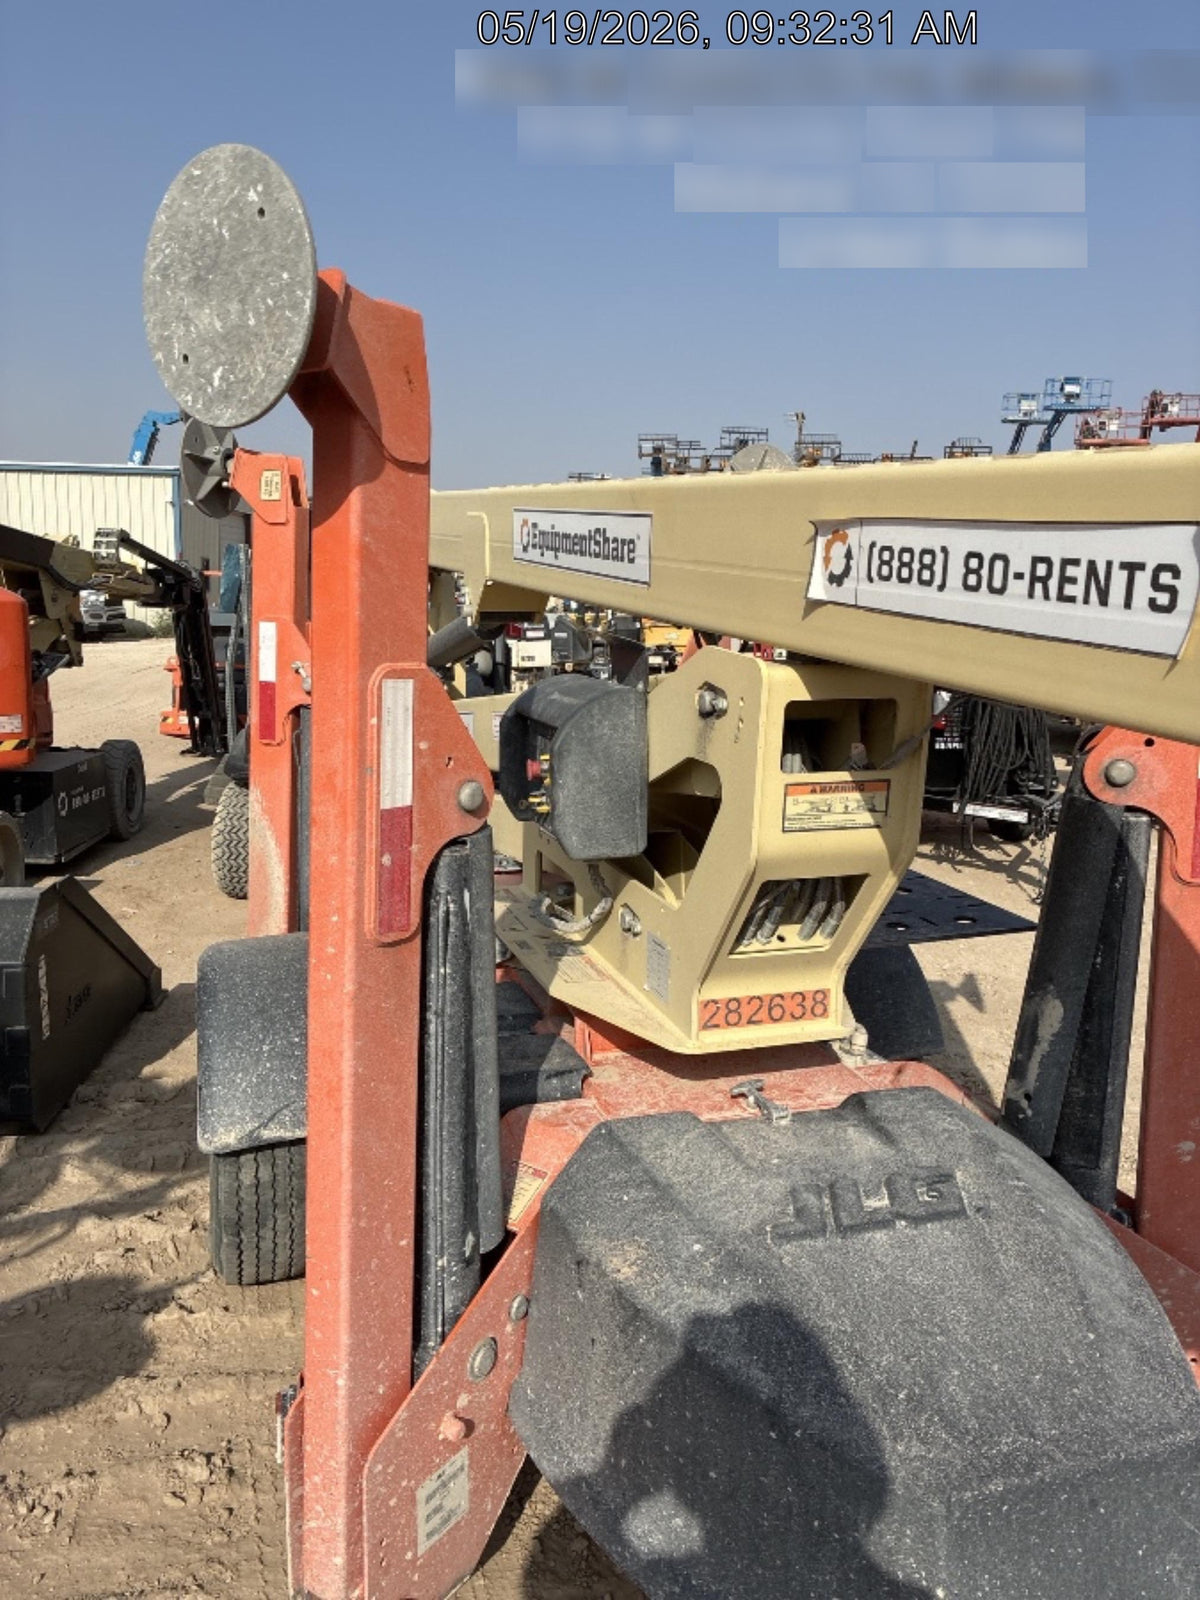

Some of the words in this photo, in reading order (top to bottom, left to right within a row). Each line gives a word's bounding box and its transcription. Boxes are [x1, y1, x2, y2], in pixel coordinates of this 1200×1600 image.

[531, 522, 636, 564] EquipmentShare
[867, 541, 949, 592] (888)
[961, 551, 1182, 614] 80-RENTS
[702, 989, 828, 1029] 282638
